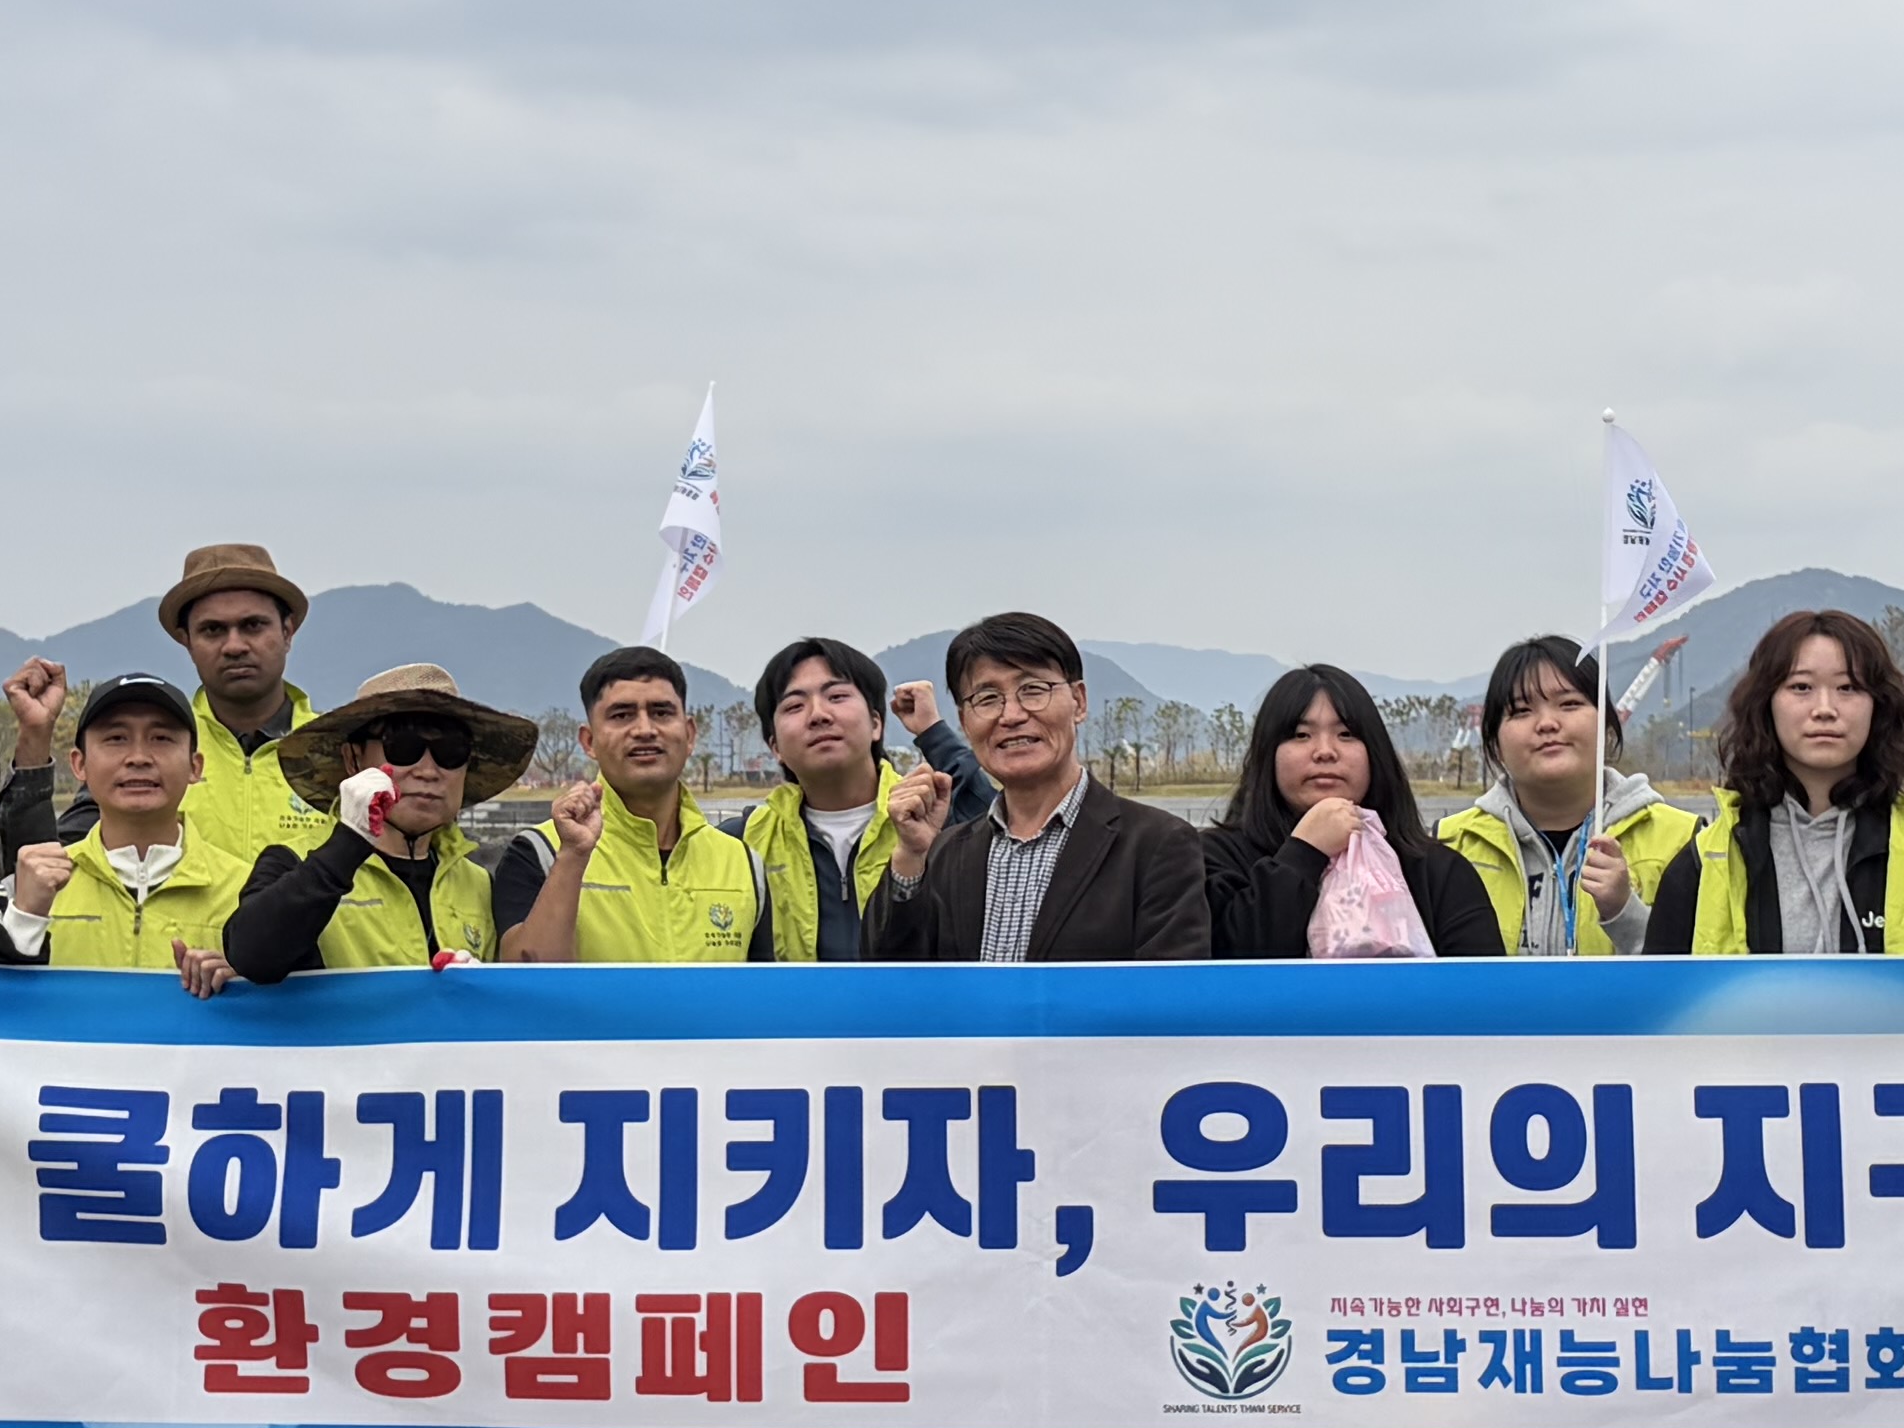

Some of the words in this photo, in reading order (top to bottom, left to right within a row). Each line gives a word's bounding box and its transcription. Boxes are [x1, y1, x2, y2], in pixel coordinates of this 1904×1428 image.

[27, 1082, 504, 1252] 쿨하게
[553, 1083, 1095, 1277] 지키자,
[1152, 1080, 1637, 1253] 우리의
[192, 1281, 912, 1404] 환경캠페인
[1329, 1296, 1421, 1317] 지속가능한
[1427, 1296, 1508, 1319] 사회구현,
[1510, 1296, 1565, 1317] 나눔의
[1571, 1296, 1607, 1317] 가치
[1613, 1296, 1649, 1317] 실현
[1267, 1404, 1302, 1414] SERVICE
